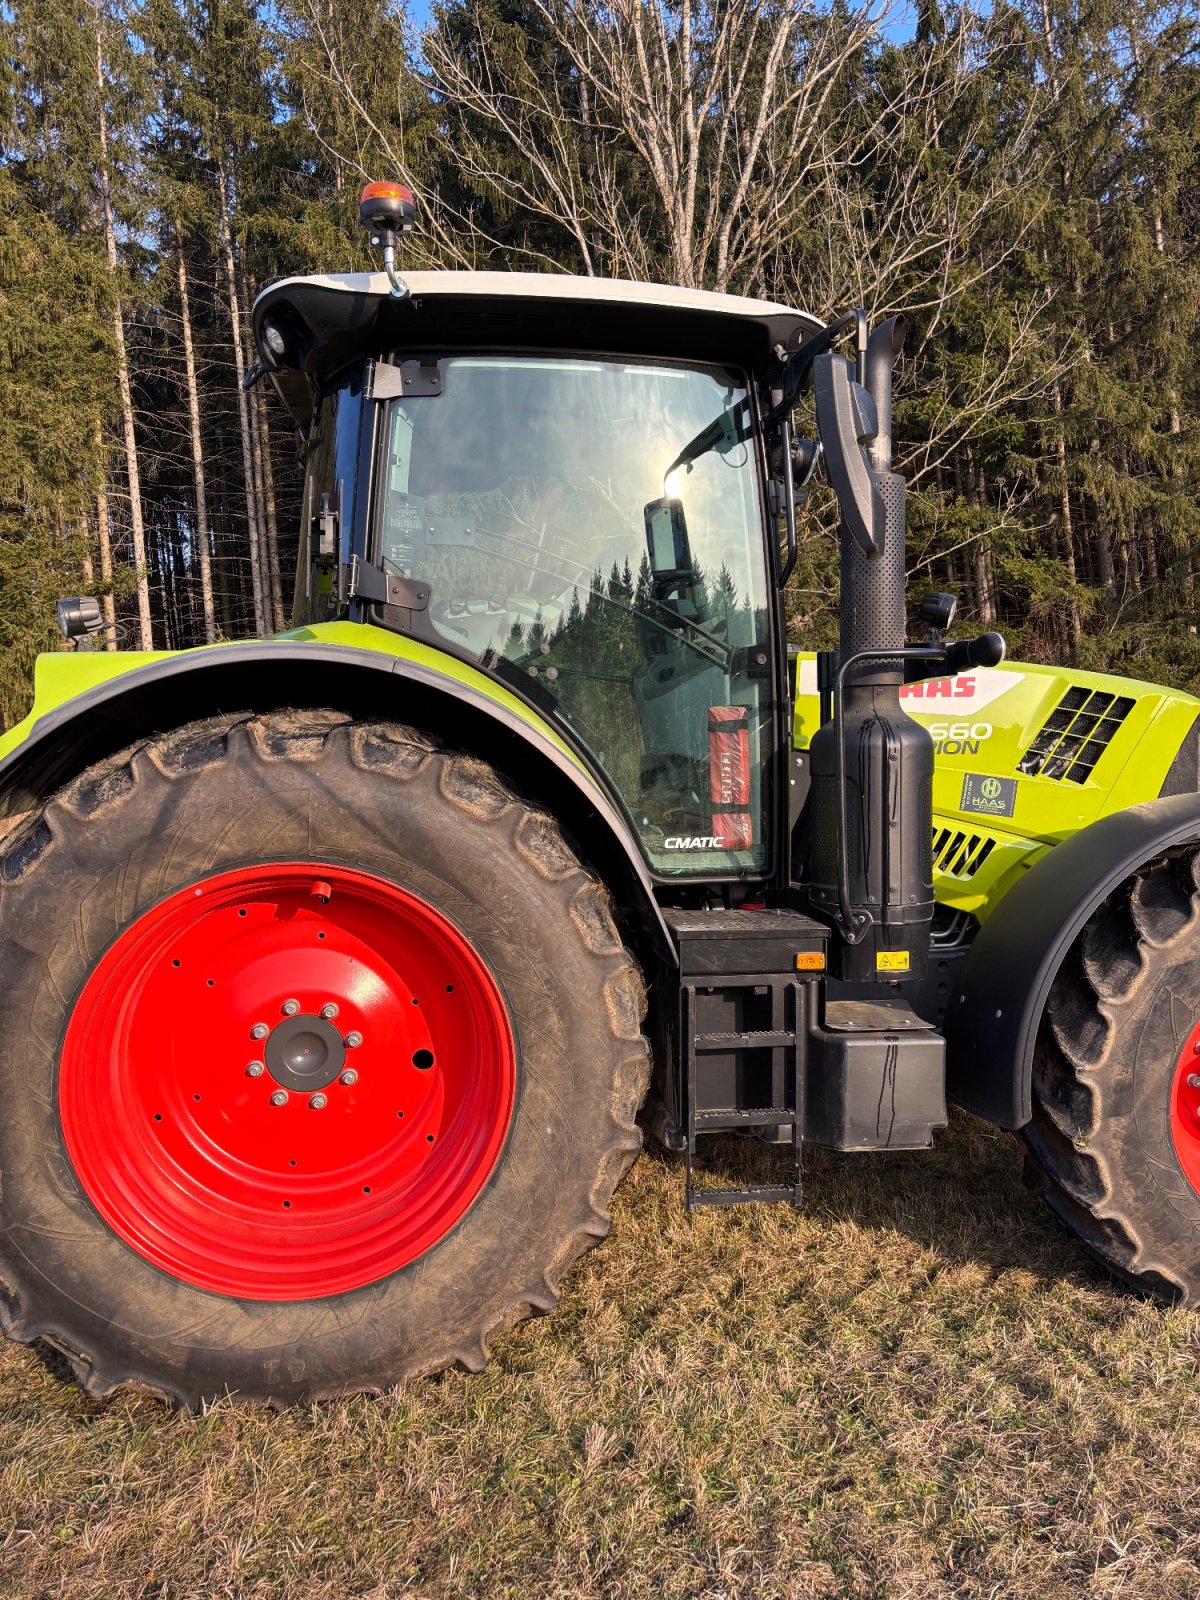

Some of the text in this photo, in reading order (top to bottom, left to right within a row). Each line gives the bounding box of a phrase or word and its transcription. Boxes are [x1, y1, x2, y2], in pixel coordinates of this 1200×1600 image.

[899, 677, 976, 698] AAS
[928, 722, 993, 741] 660
[933, 741, 980, 755] ION
[972, 797, 1006, 810] HAAS
[664, 836, 725, 849] CMATIC
